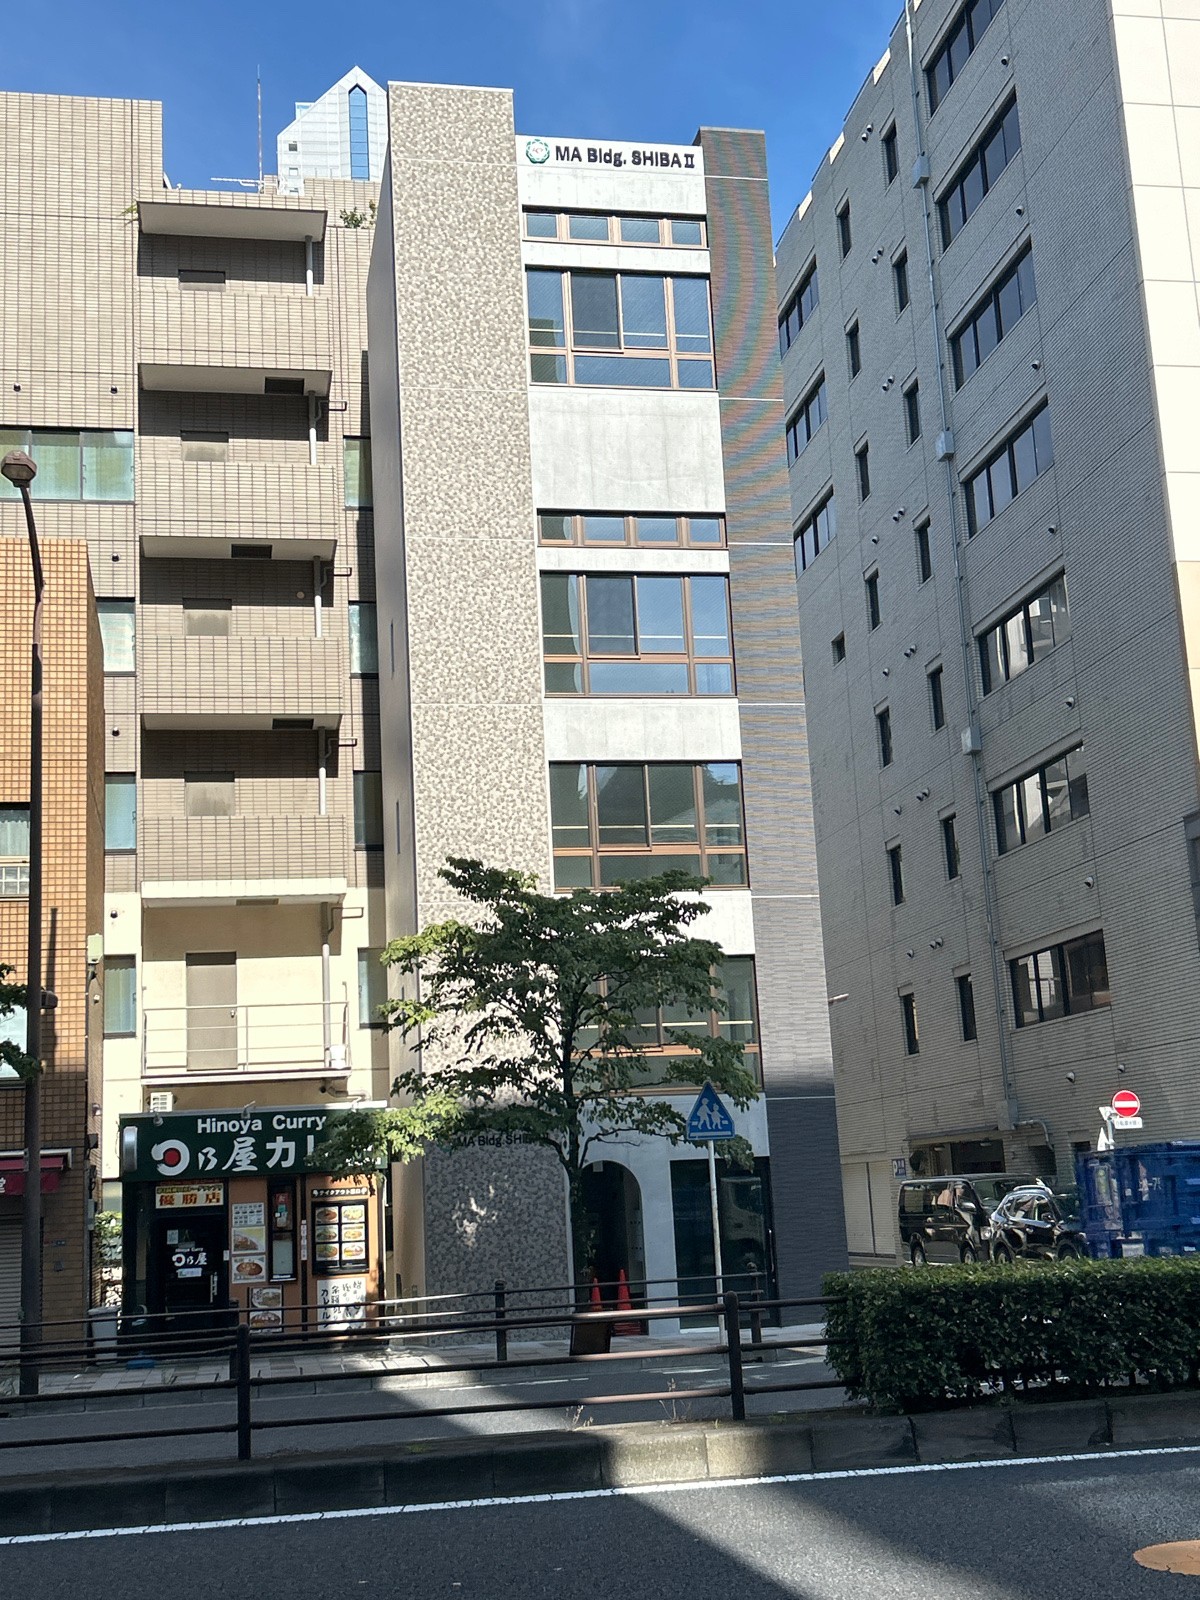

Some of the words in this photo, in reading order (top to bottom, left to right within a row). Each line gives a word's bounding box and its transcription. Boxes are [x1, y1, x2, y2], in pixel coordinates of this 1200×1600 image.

[555, 145, 583, 163] MA
[587, 147, 627, 168] Bldg.
[197, 1118, 263, 1135] Hinoya
[272, 1114, 327, 1131] Curry
[159, 1191, 221, 1206] 優勝店
